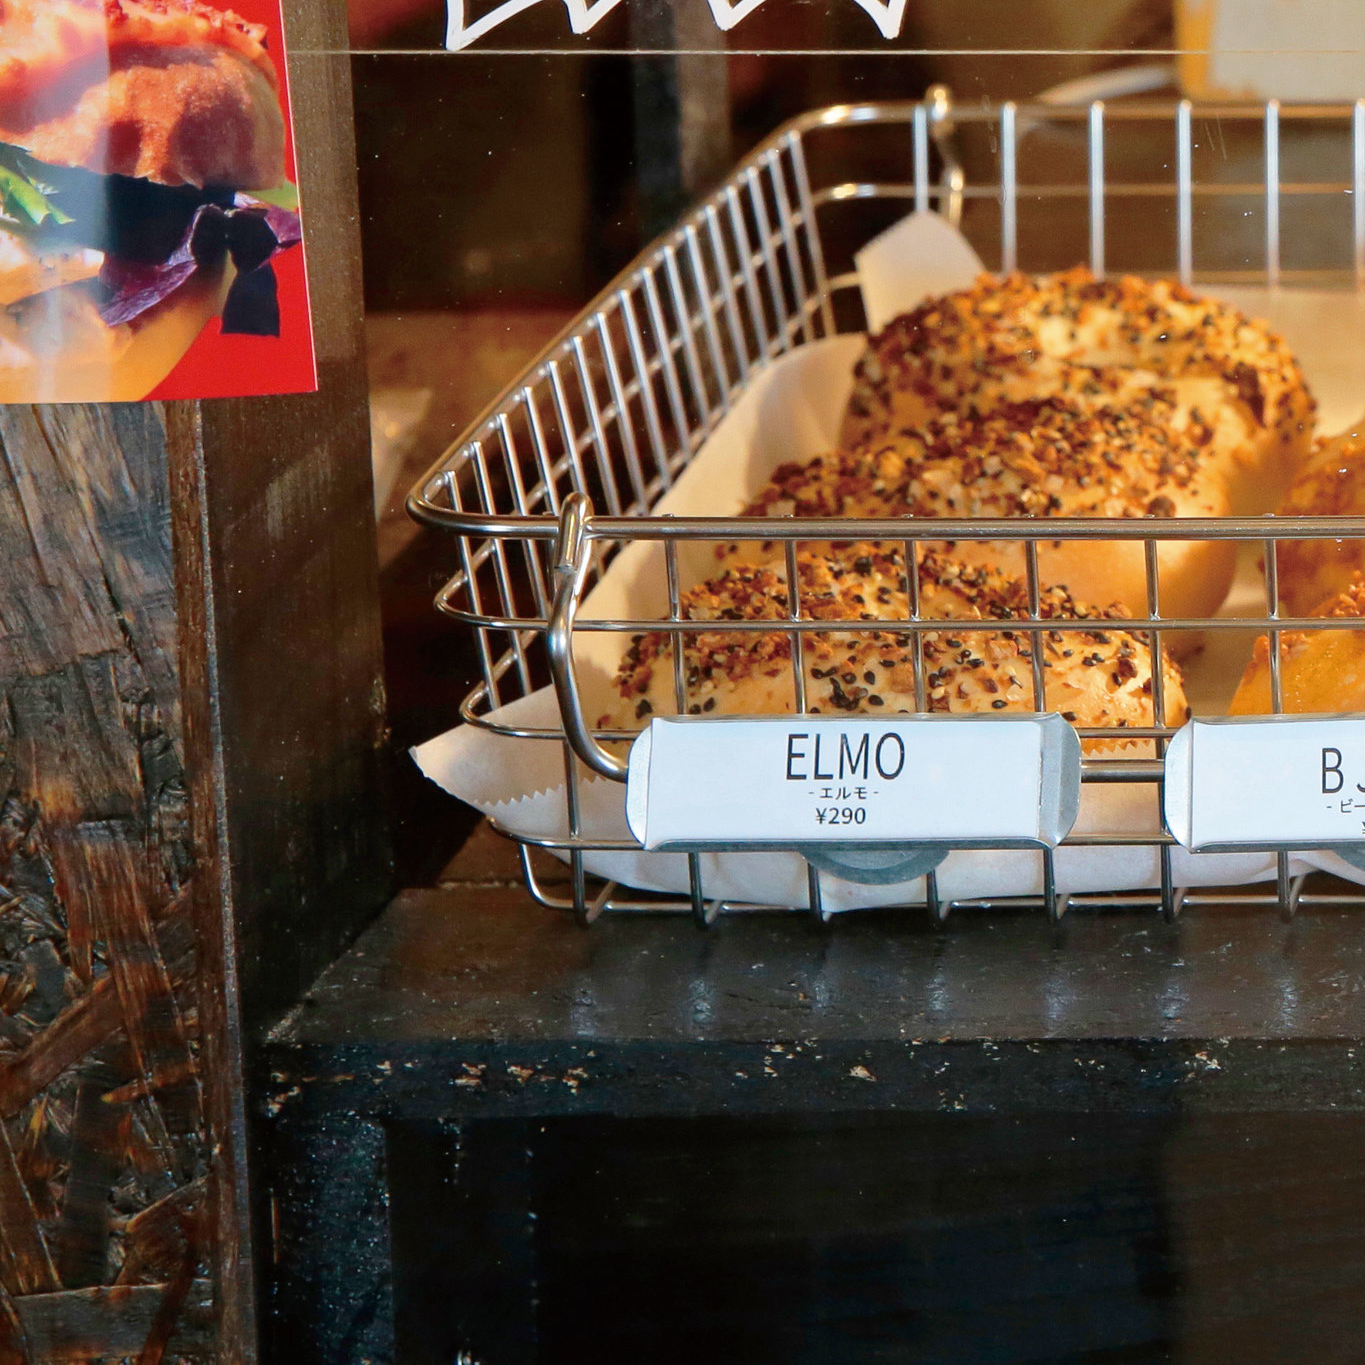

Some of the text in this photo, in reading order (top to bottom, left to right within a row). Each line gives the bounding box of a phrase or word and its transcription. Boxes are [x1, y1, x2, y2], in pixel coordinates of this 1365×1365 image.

[785, 732, 906, 781] ELMO
[1320, 747, 1345, 795] B
[815, 807, 867, 826] ¥290
